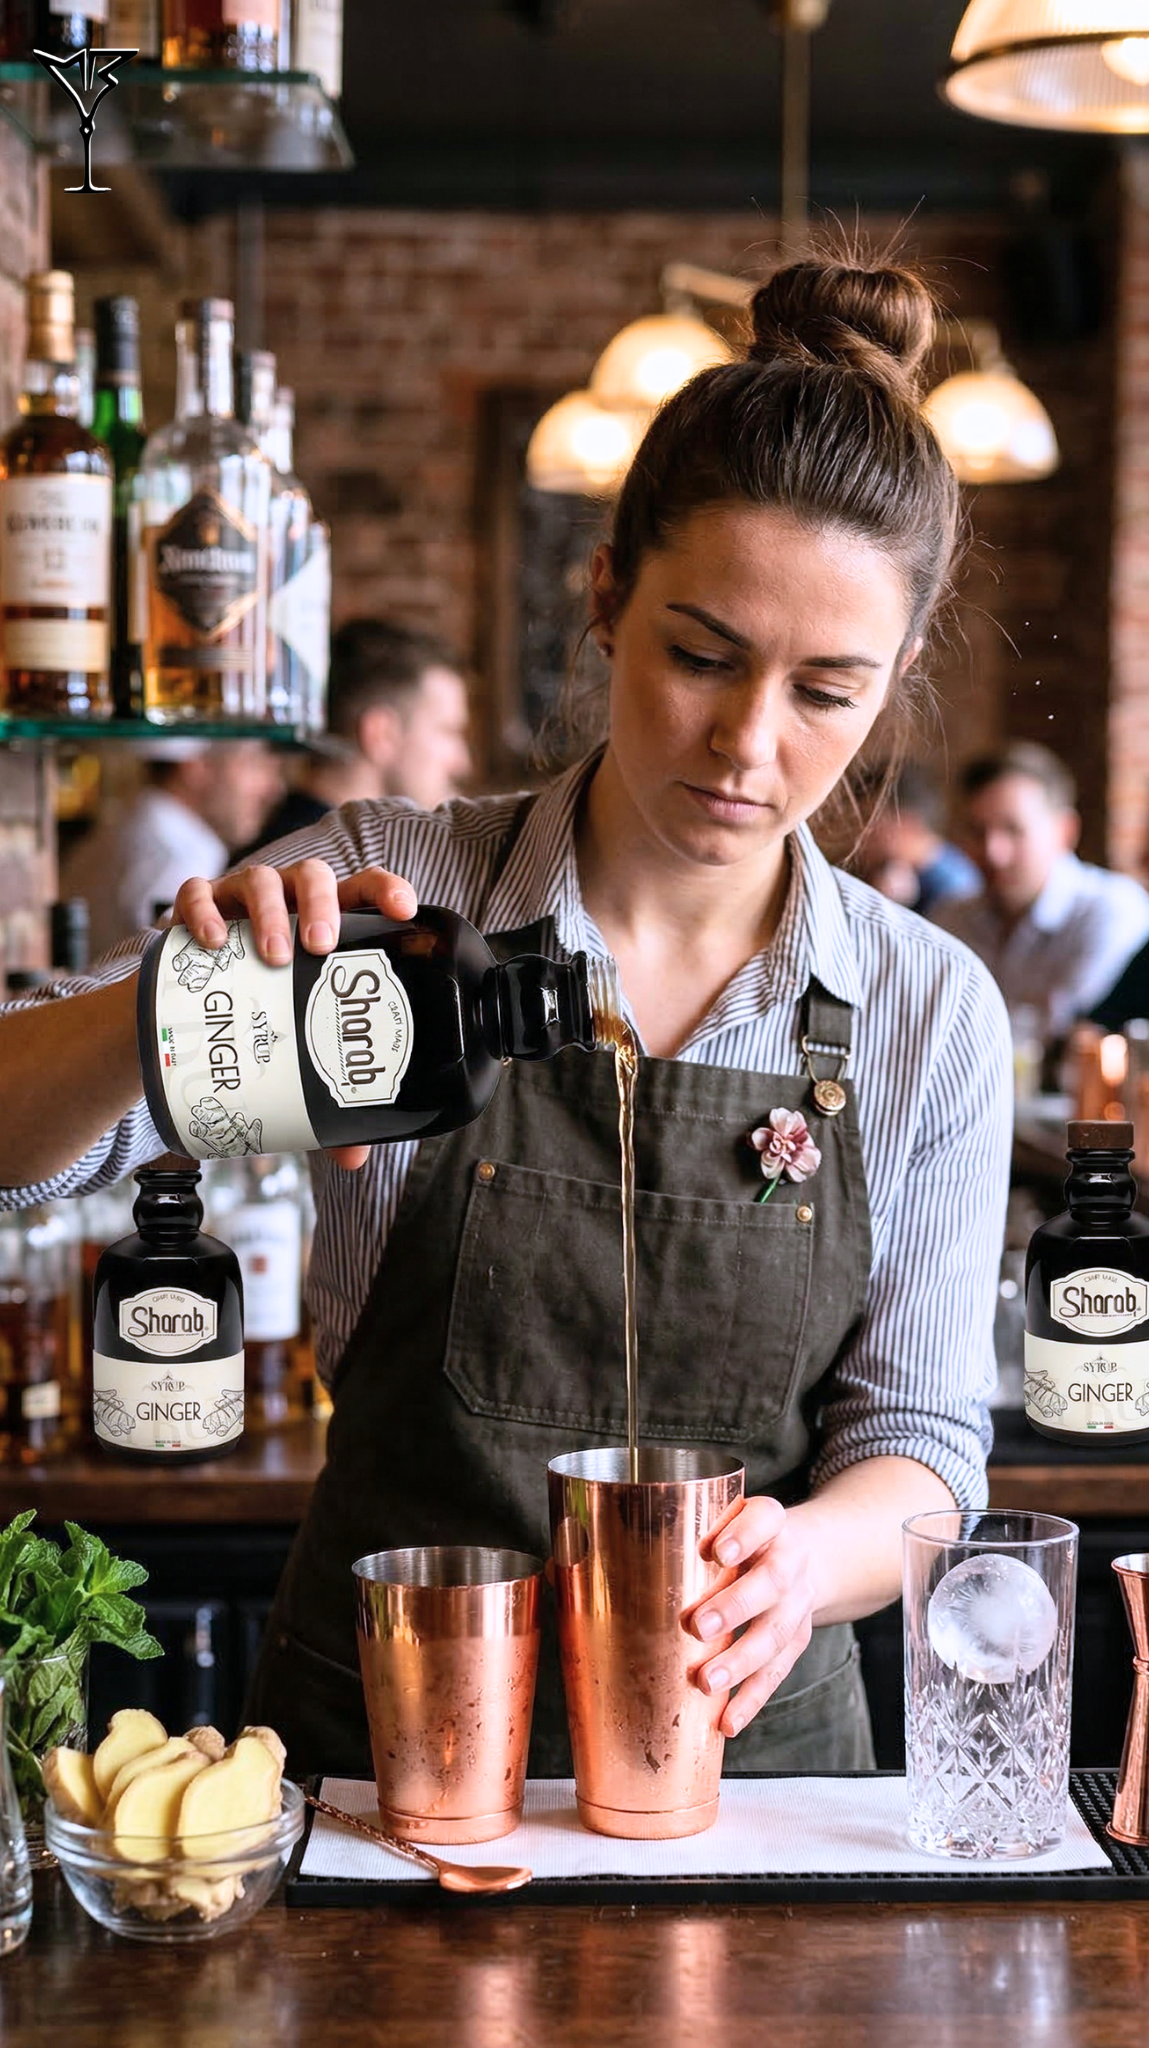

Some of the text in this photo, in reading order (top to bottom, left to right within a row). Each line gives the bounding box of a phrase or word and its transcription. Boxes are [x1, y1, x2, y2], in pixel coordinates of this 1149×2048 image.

[204, 990, 241, 1093] GINGER
[251, 1011, 271, 1064] SYRUP
[331, 965, 386, 1087] Sharab
[1059, 1286, 1137, 1318] Sharab
[127, 1306, 204, 1338] Sharab
[1083, 1362, 1118, 1373] SYRUP
[1068, 1383, 1134, 1403] GINGER
[136, 1402, 201, 1421] GINGER
